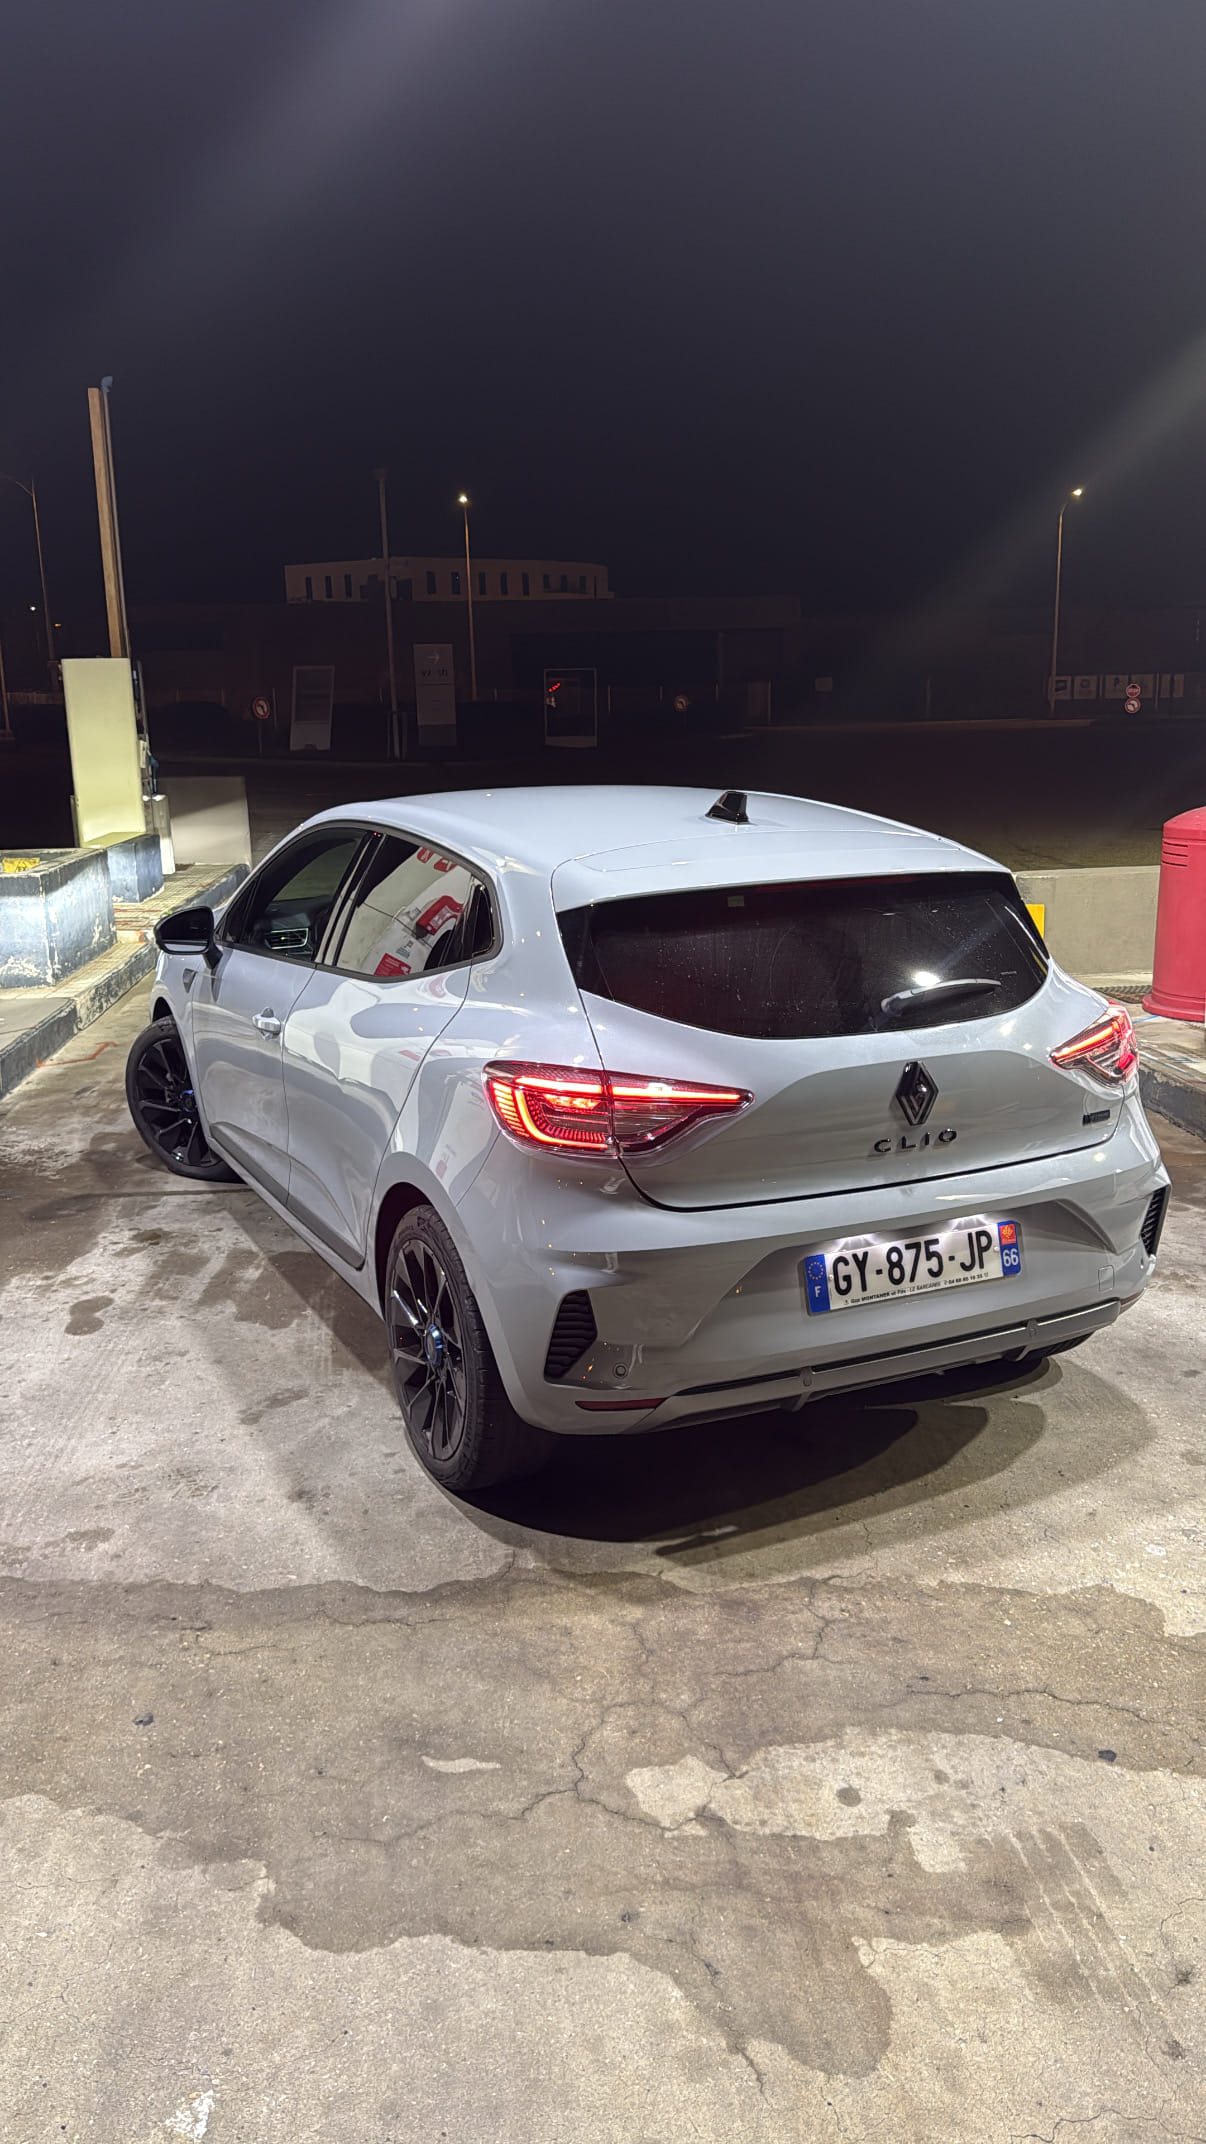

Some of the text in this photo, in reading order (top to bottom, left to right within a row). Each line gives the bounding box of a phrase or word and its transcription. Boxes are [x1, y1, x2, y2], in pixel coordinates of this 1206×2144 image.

[874, 1129, 957, 1152] CLIO
[832, 1230, 993, 1296] GY-875-JP
[1003, 1248, 1019, 1267] 66
[814, 1286, 821, 1298] F
